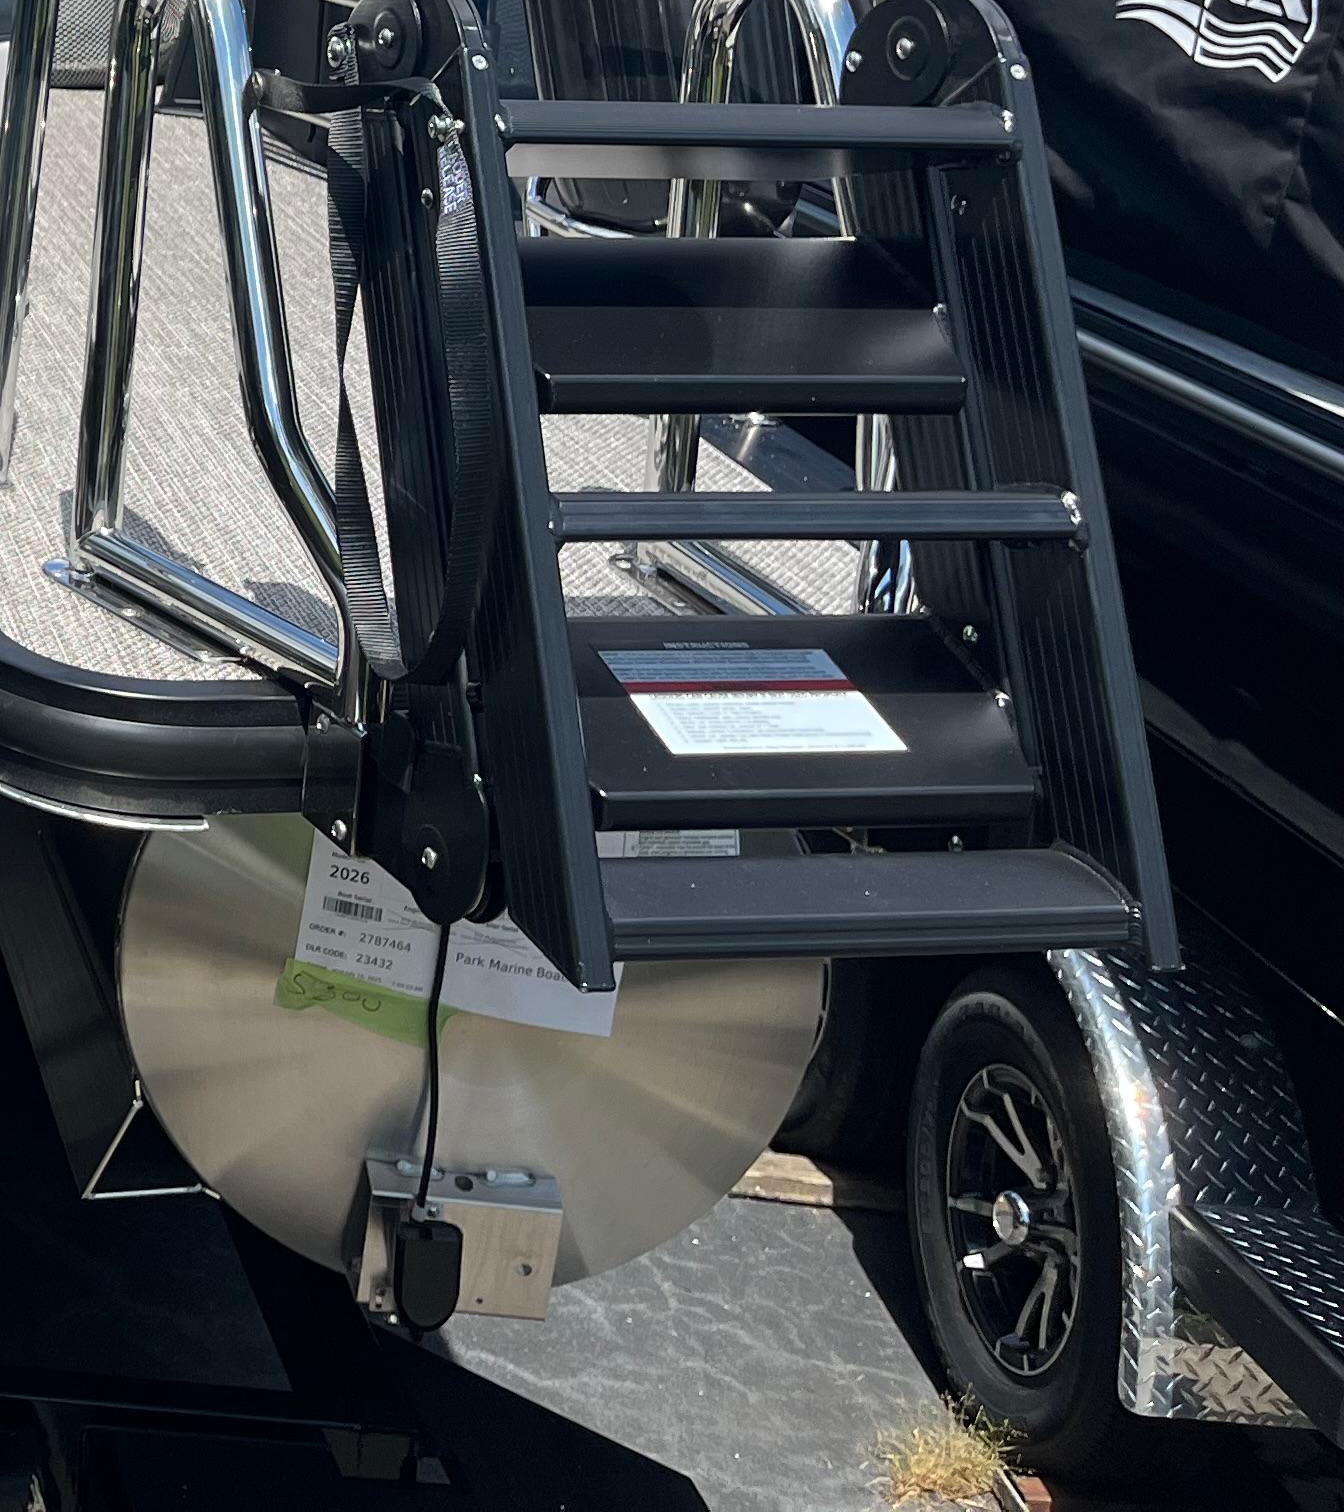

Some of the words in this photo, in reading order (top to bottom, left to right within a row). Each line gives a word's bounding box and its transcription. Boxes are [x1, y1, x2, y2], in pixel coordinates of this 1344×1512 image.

[329, 864, 371, 885] 2026
[309, 922, 336, 935] ORDER
[359, 932, 412, 953] 2787464
[355, 953, 394, 970] 23432
[455, 952, 485, 968] Park
[488, 959, 534, 977] Marine
